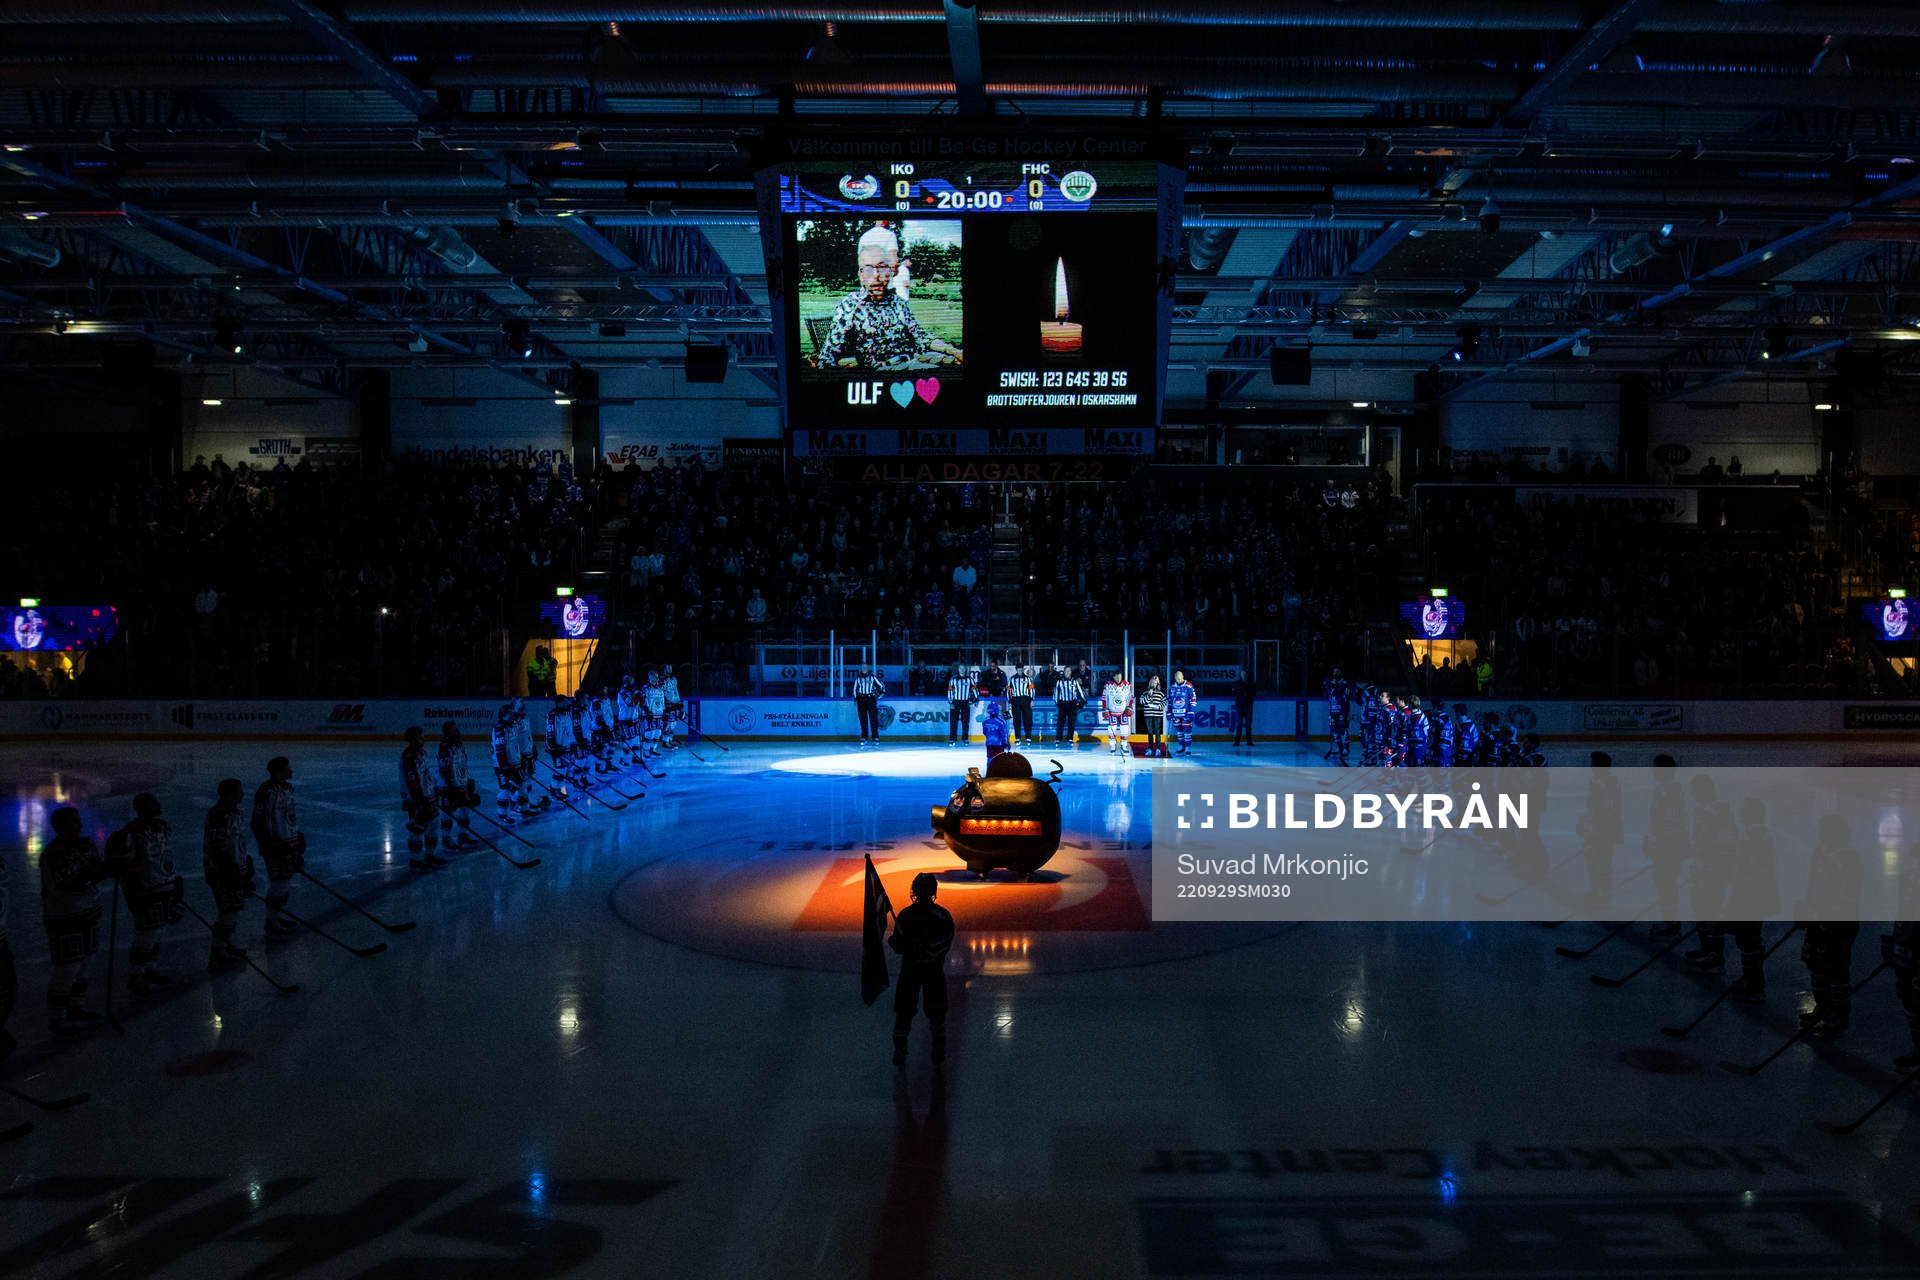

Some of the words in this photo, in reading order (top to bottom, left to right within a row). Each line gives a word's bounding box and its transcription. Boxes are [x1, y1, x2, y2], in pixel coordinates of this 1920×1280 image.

[788, 138, 900, 156] Välkommen
[909, 138, 932, 155] till
[938, 138, 998, 156] Be-Ge
[1004, 138, 1076, 158] Hockey
[1082, 138, 1149, 156] Center
[890, 163, 914, 176] IKO
[1022, 163, 1051, 176] FHC
[894, 180, 910, 198] 0
[1028, 180, 1044, 198] 0
[937, 191, 1002, 209] 20:00
[999, 371, 1039, 388] SWISH:
[1042, 371, 1063, 388] 123
[1065, 371, 1089, 388] 645
[1092, 371, 1109, 388] 38
[1111, 371, 1128, 387] 56
[847, 382, 883, 405] ULF
[986, 393, 1076, 407] BROTTSOFFERJOUREN
[1082, 393, 1138, 406] OSKARSHAMN
[620, 444, 659, 458] EPAB
[861, 462, 940, 481] ALLA
[943, 462, 1041, 481] DAGAR
[1049, 462, 1105, 481] 7-22
